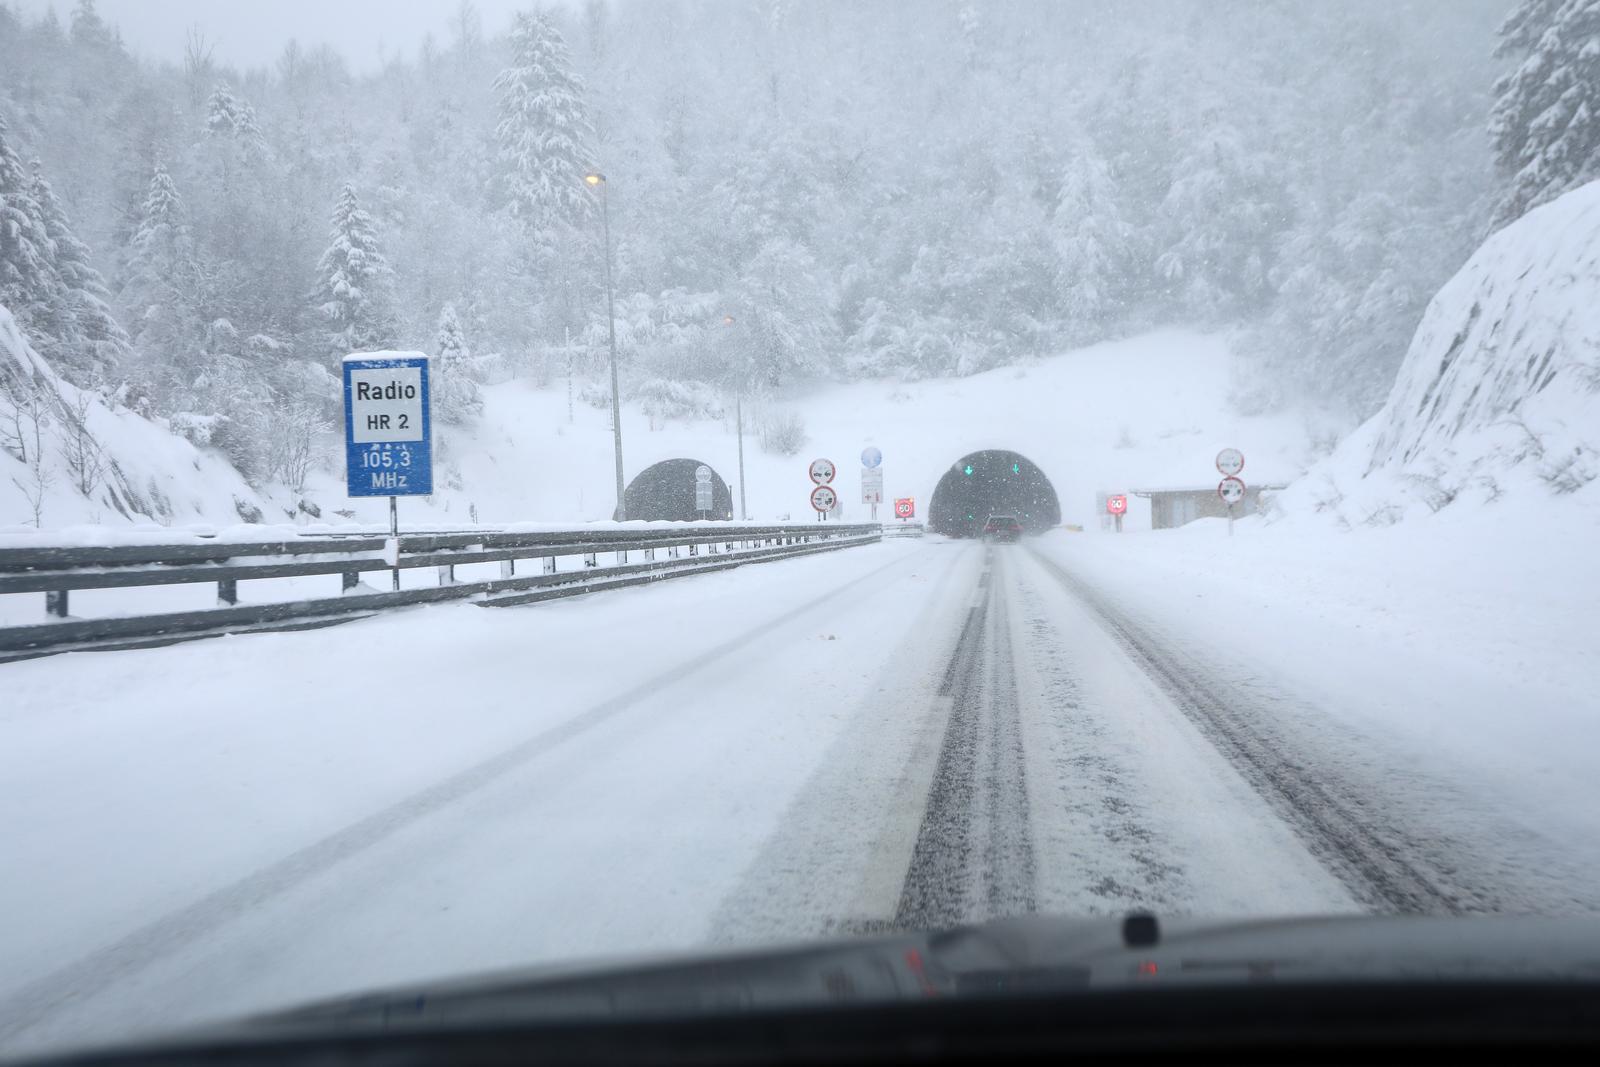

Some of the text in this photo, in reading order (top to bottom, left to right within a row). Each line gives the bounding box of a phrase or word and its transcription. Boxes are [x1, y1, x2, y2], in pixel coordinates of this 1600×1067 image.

[357, 381, 416, 401] Radio
[367, 414, 410, 430] HR 2
[362, 451, 411, 470] 105,3
[371, 472, 408, 489] MHz
